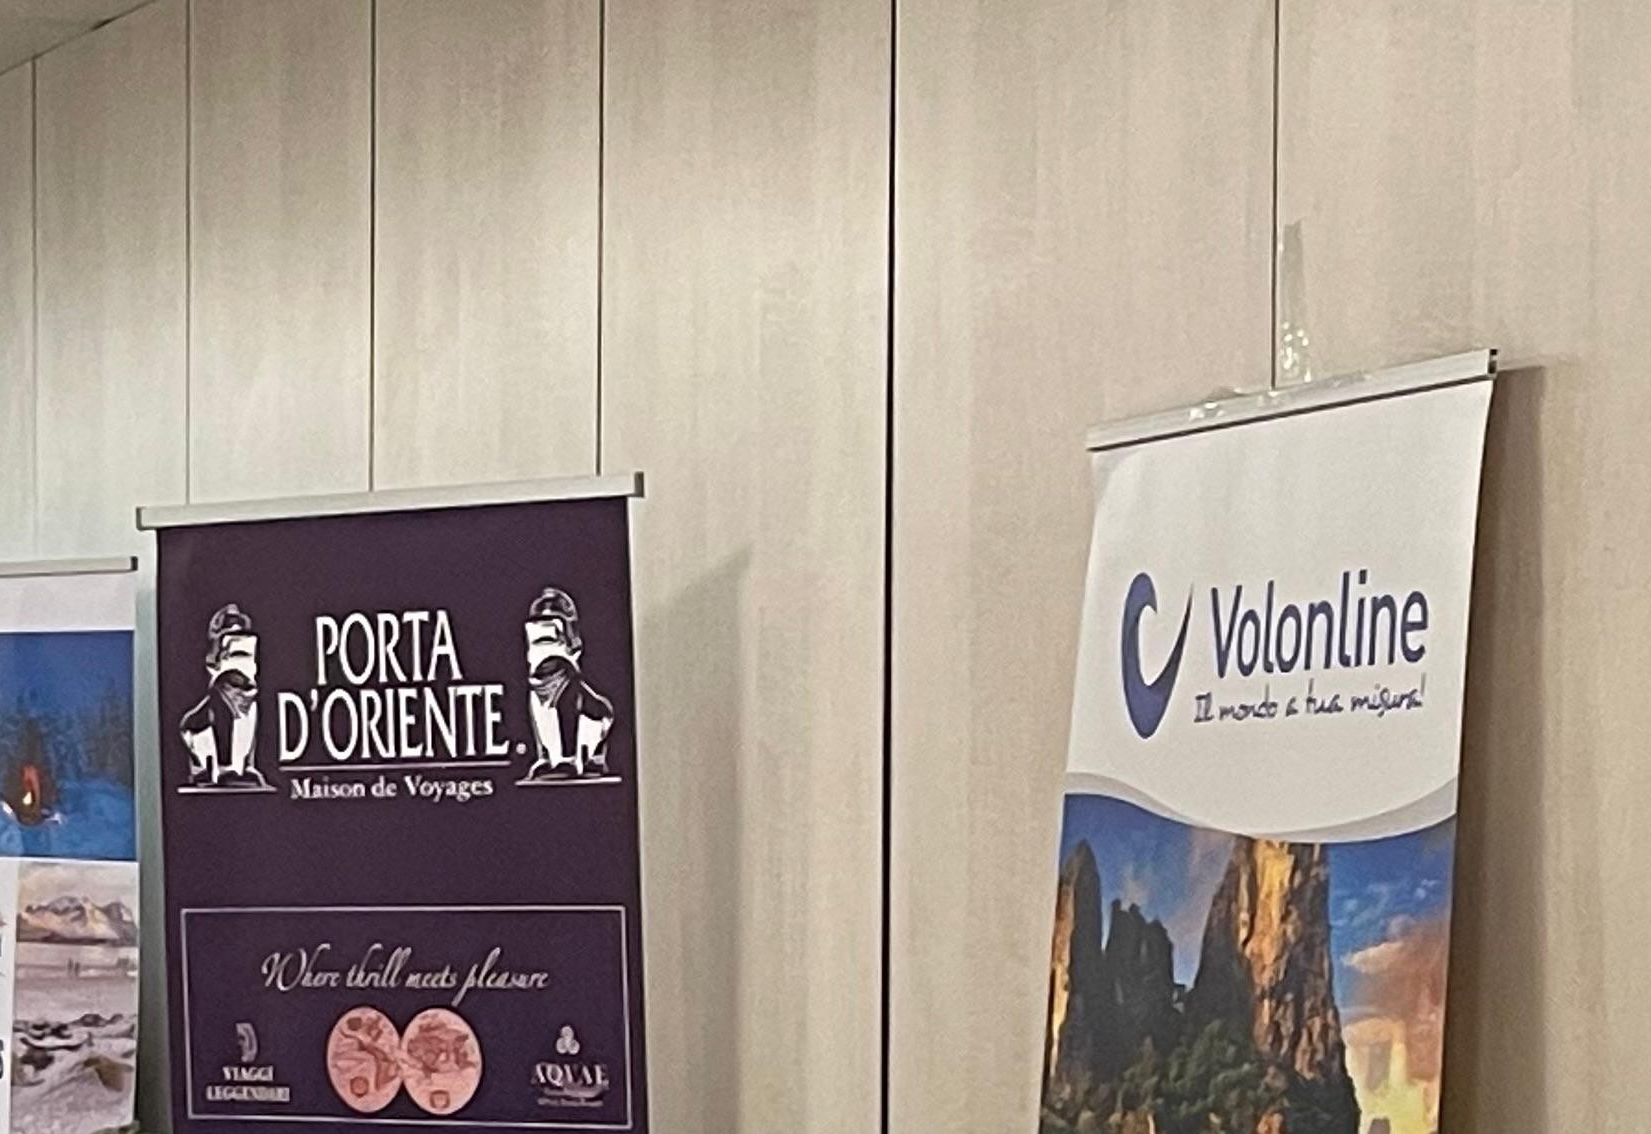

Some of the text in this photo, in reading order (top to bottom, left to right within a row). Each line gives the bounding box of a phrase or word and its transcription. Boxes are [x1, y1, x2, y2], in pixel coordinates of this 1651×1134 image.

[315, 609, 464, 686] PORTA
[1210, 568, 1429, 680] Volonline
[1193, 691, 1214, 723] Il
[1218, 682, 1279, 722] mondo
[1285, 696, 1299, 718] a
[1306, 677, 1344, 715] tua
[289, 773, 494, 802] Maison de Voyages
[260, 943, 549, 1008] Where thrill meets pleasure
